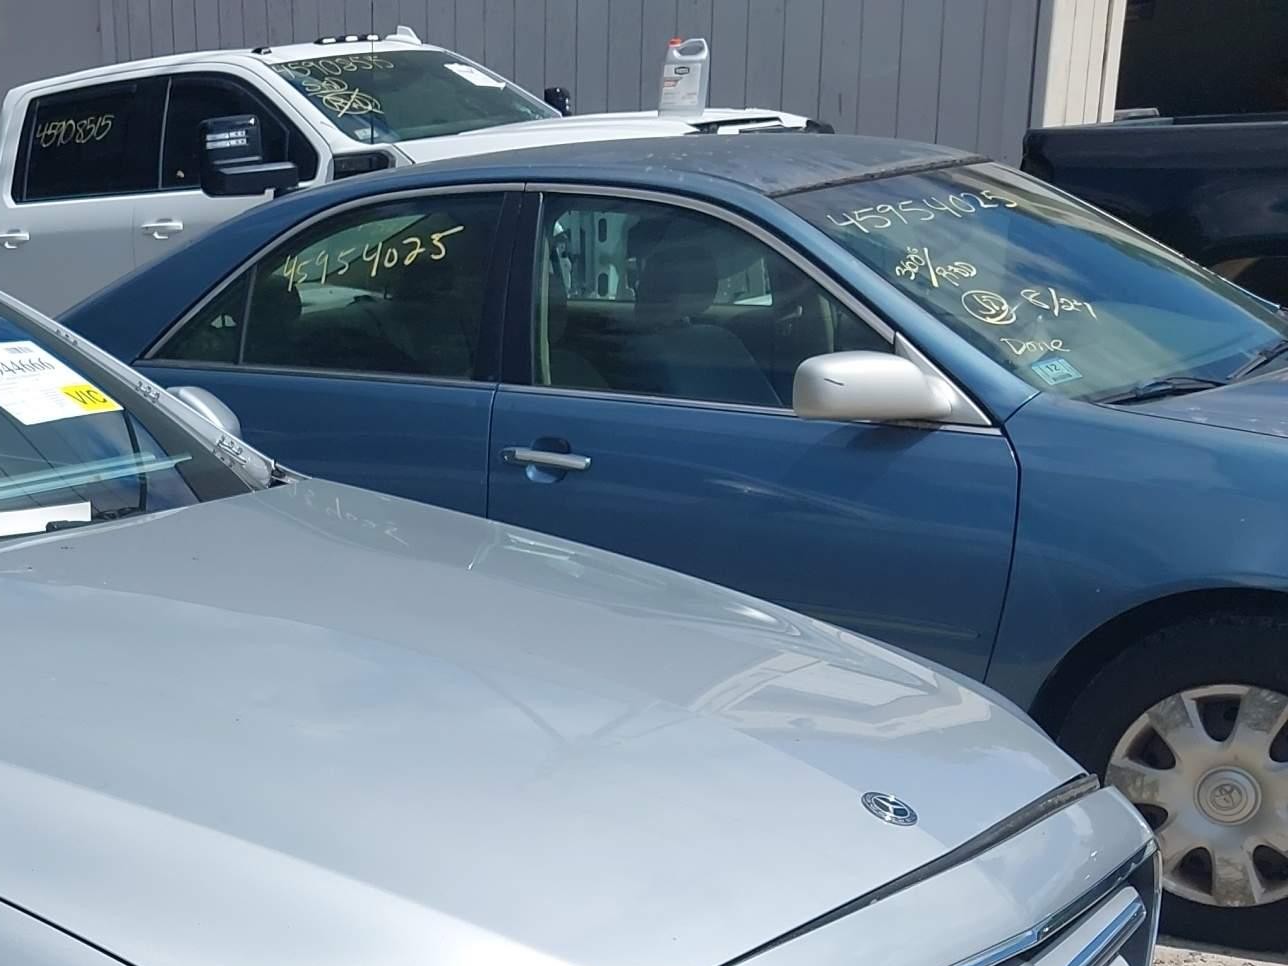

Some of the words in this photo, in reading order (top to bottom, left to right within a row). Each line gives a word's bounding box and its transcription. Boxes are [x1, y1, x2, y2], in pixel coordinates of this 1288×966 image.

[826, 190, 1017, 233] 45954025
[283, 225, 464, 292] 45954025
[1000, 337, 1070, 355] Done
[64, 389, 109, 406] VIC
